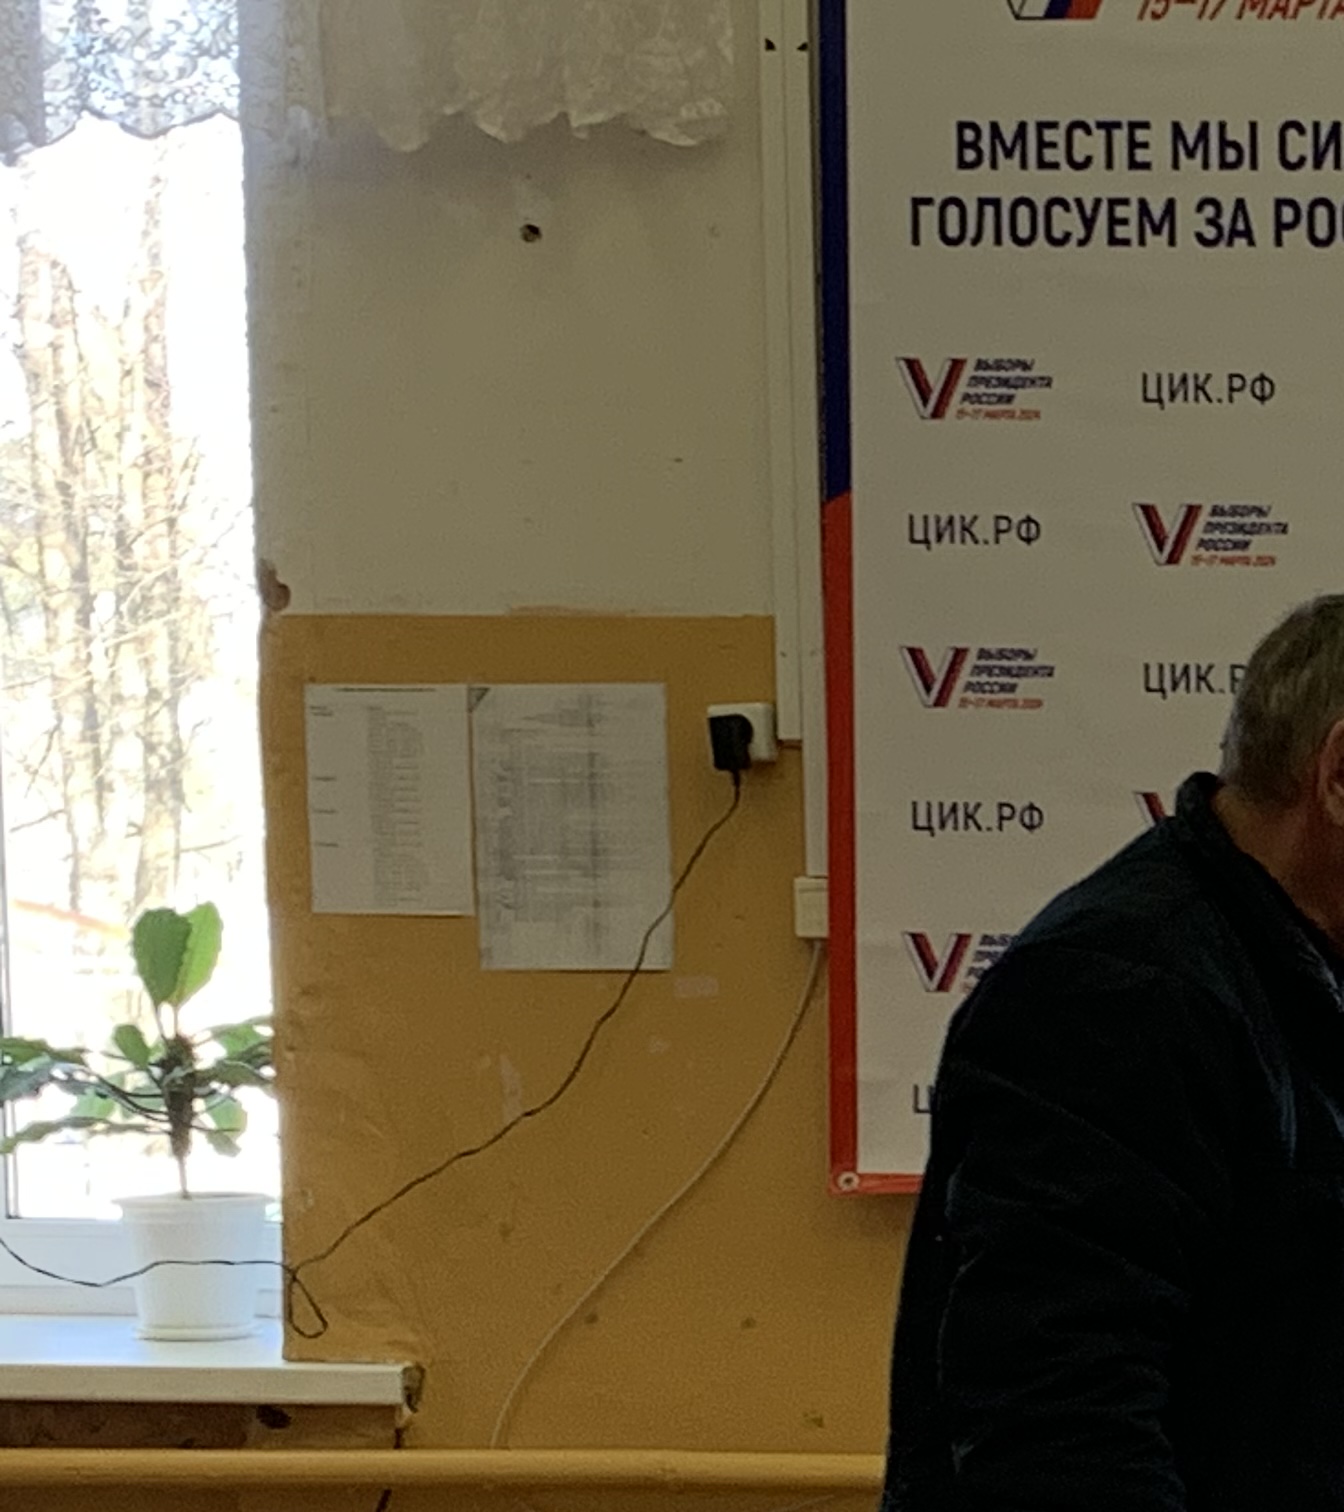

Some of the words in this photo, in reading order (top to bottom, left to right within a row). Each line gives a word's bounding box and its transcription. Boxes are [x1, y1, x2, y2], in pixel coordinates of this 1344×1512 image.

[954, 119, 1153, 172] ВМЕСТЕ
[1170, 119, 1260, 172] МЫ
[910, 195, 1178, 249] ГОЛОСУЕМ
[1193, 195, 1258, 249] ЗА
[1141, 372, 1277, 411] ЦИК.РФ
[908, 513, 1042, 552] ЦИК.РФ
[1143, 662, 1249, 700] ЦИК.Р
[911, 800, 1045, 838] ЦИК.РФ
